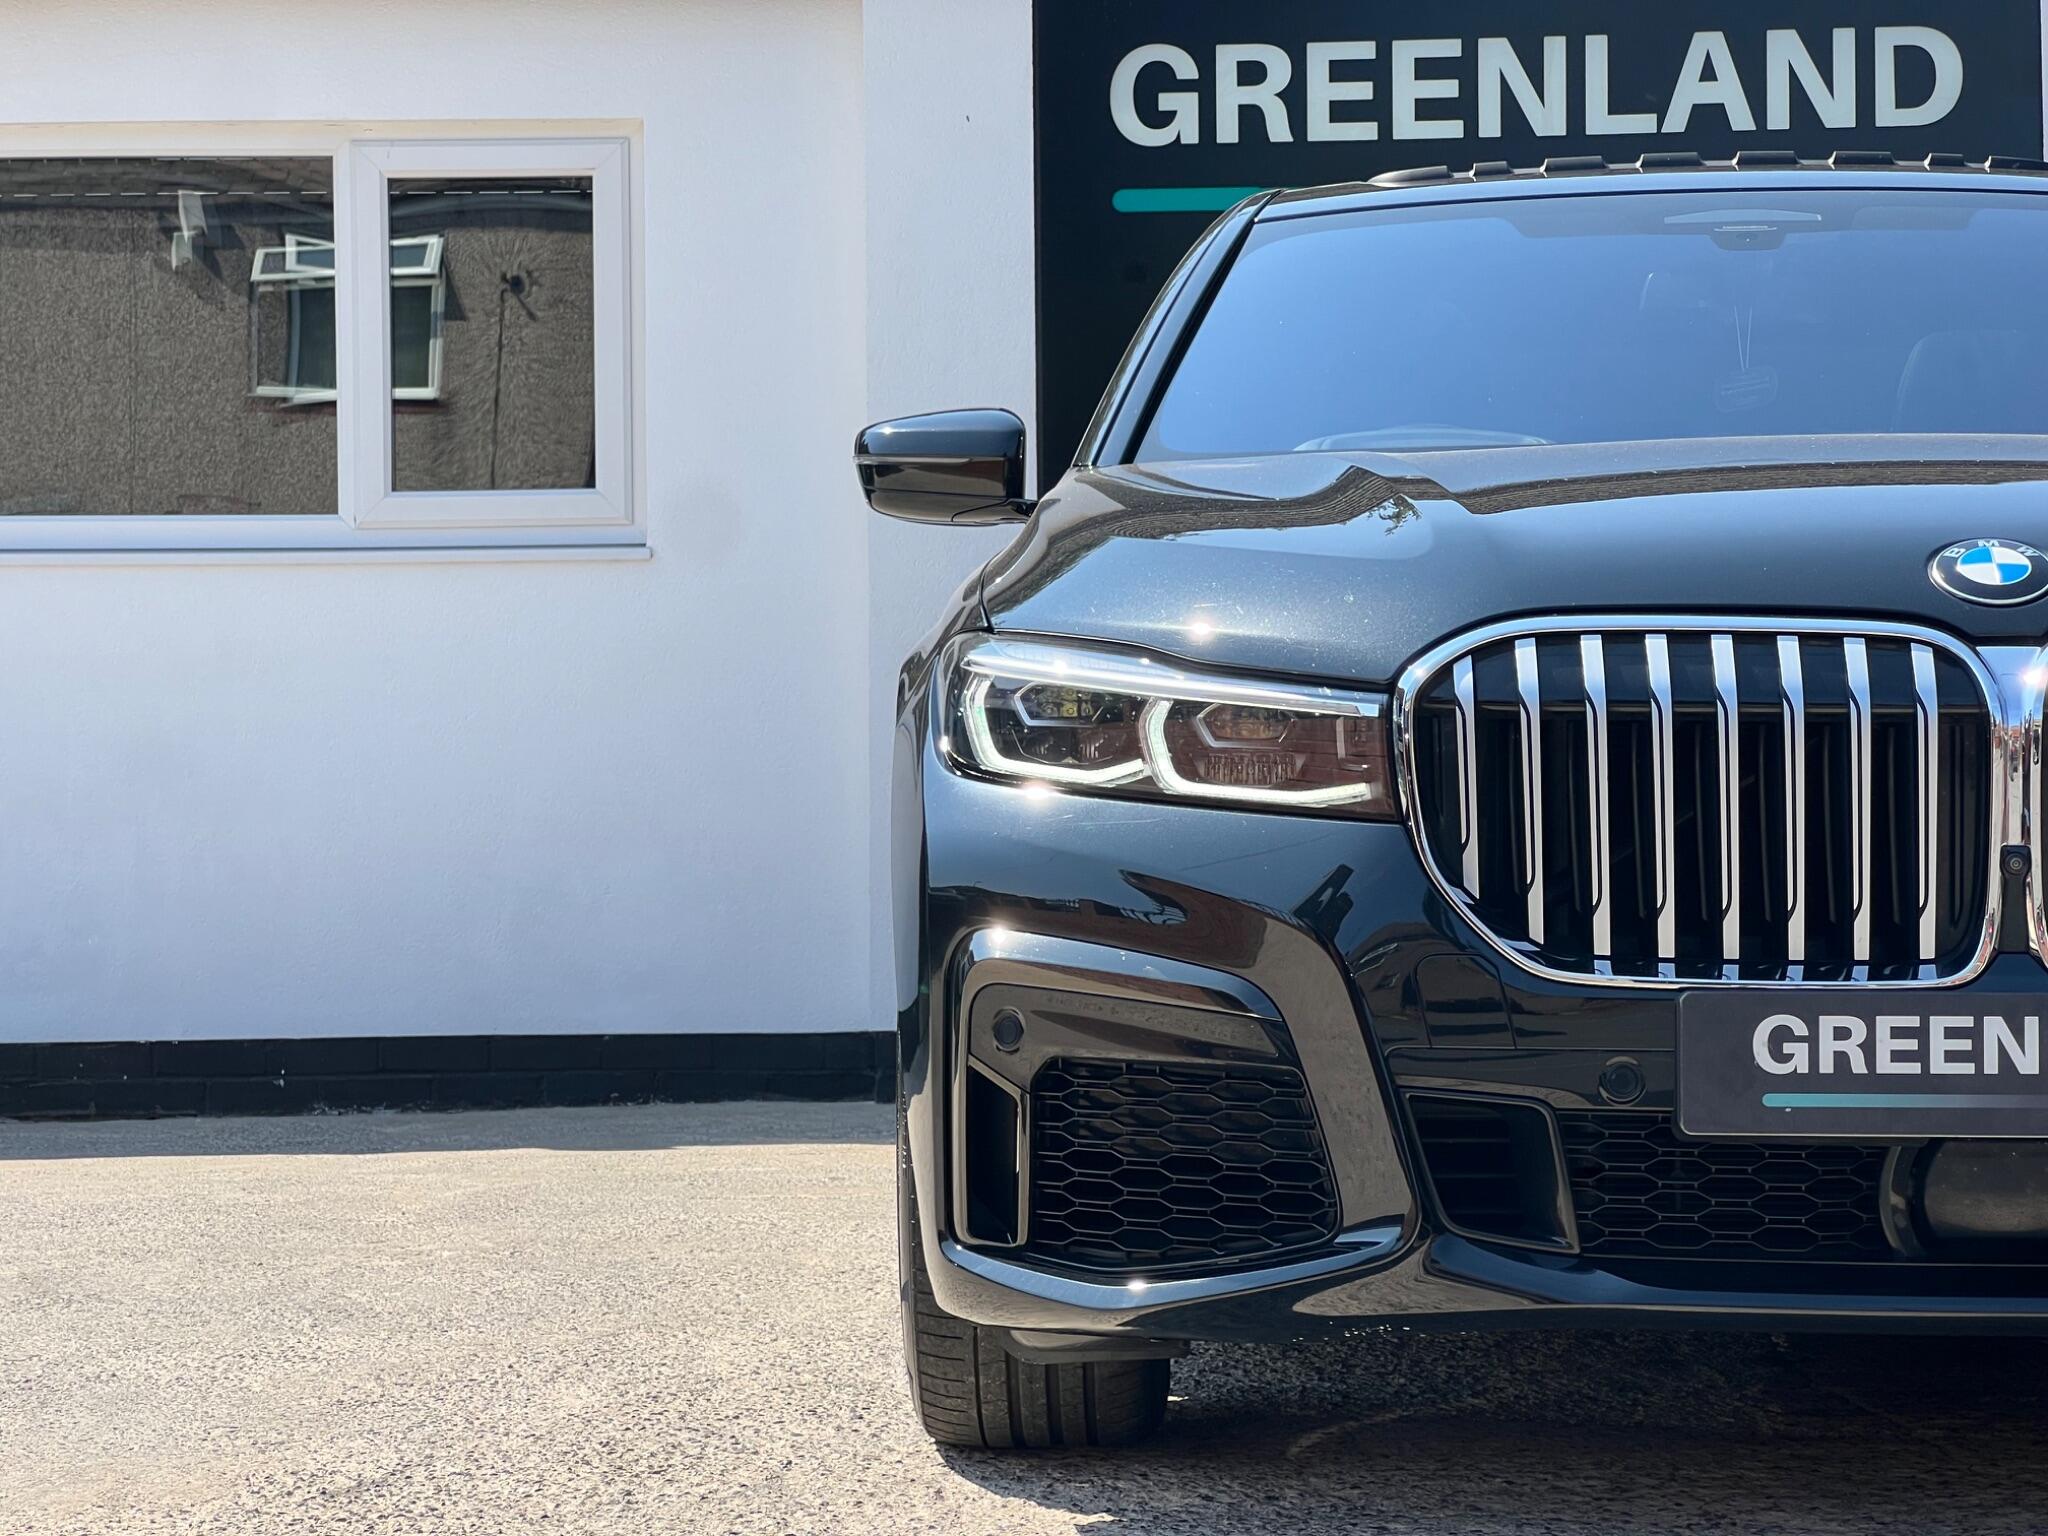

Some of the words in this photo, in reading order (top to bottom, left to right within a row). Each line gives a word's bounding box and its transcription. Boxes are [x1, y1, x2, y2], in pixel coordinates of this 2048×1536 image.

[1110, 26, 1964, 146] GREENLAND
[1943, 540, 2039, 557] BMW
[1753, 1014, 2040, 1075] GREEN
